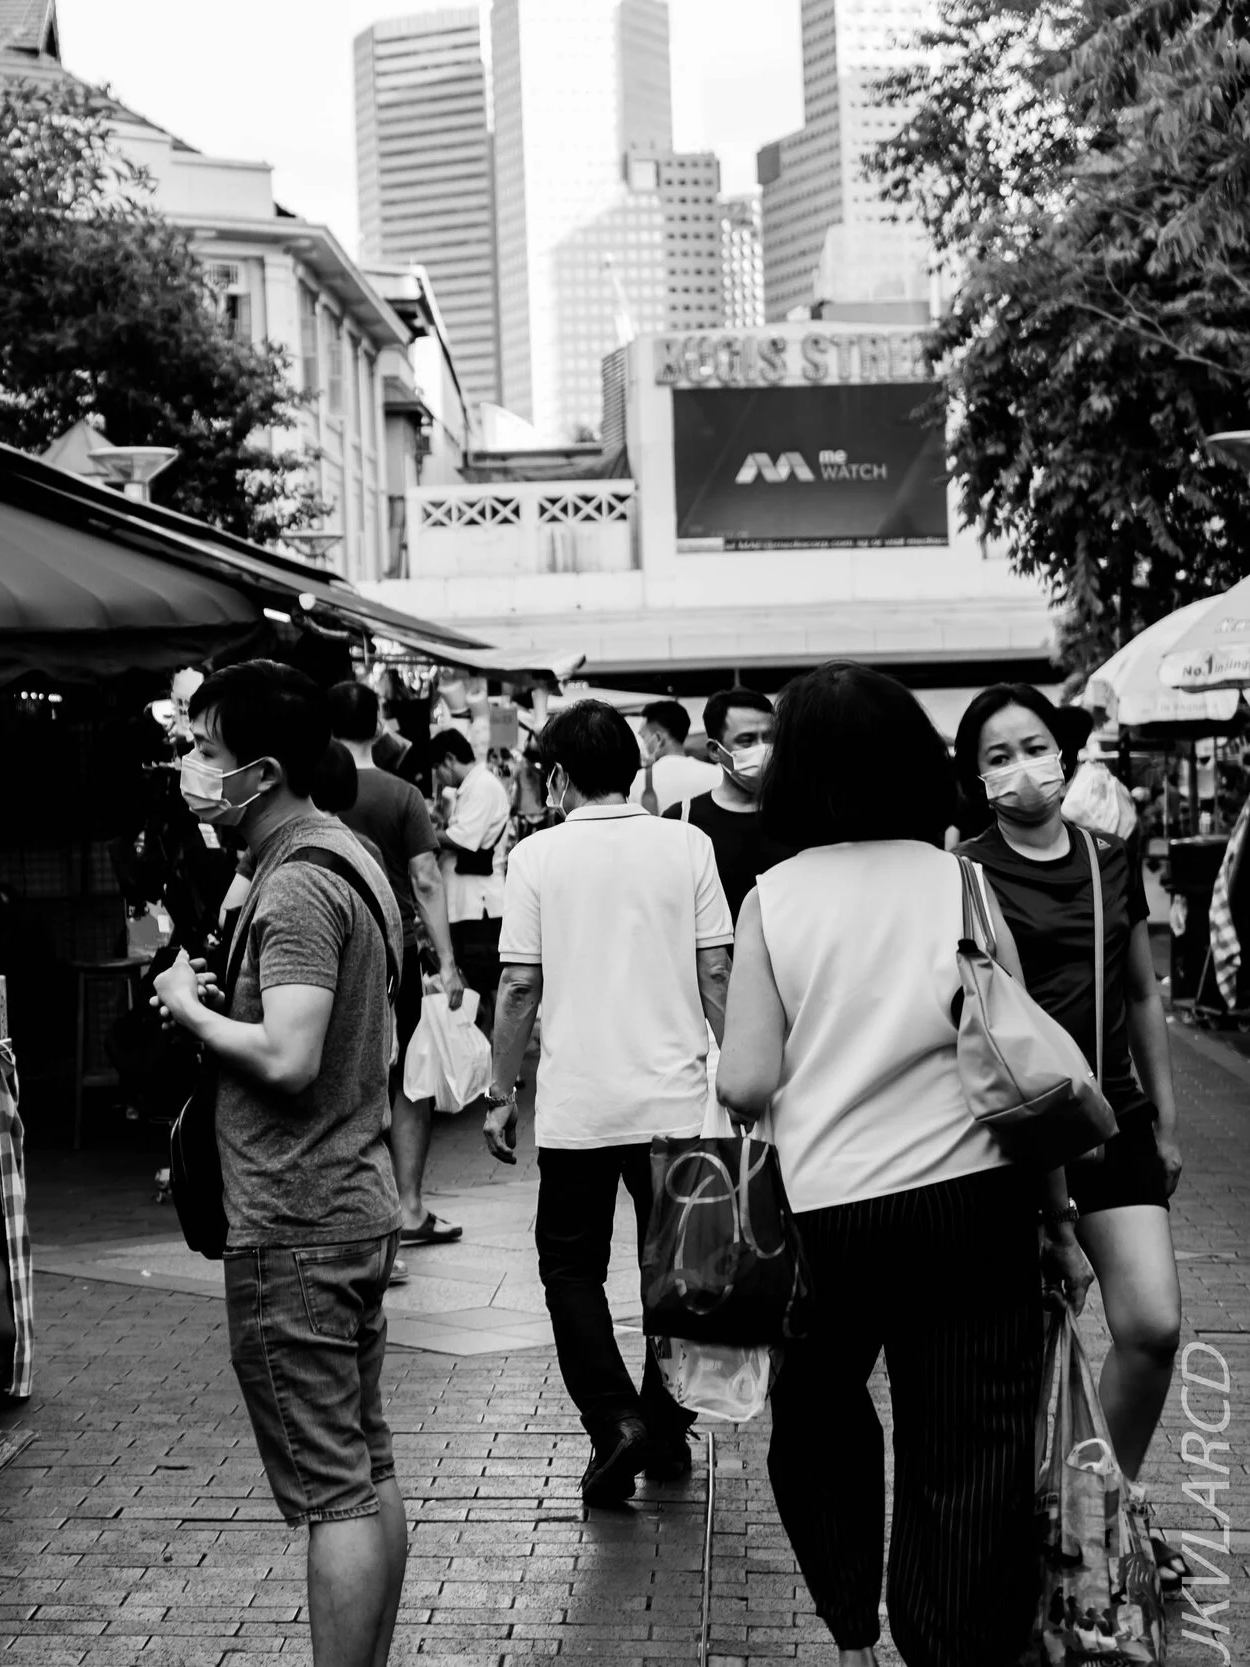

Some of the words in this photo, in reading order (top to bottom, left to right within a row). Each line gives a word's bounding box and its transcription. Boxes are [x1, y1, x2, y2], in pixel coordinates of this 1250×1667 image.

[655, 333, 787, 386] BUGIS
[801, 331, 931, 384] STRE
[819, 449, 847, 464] me
[820, 463, 888, 482] WATCH
